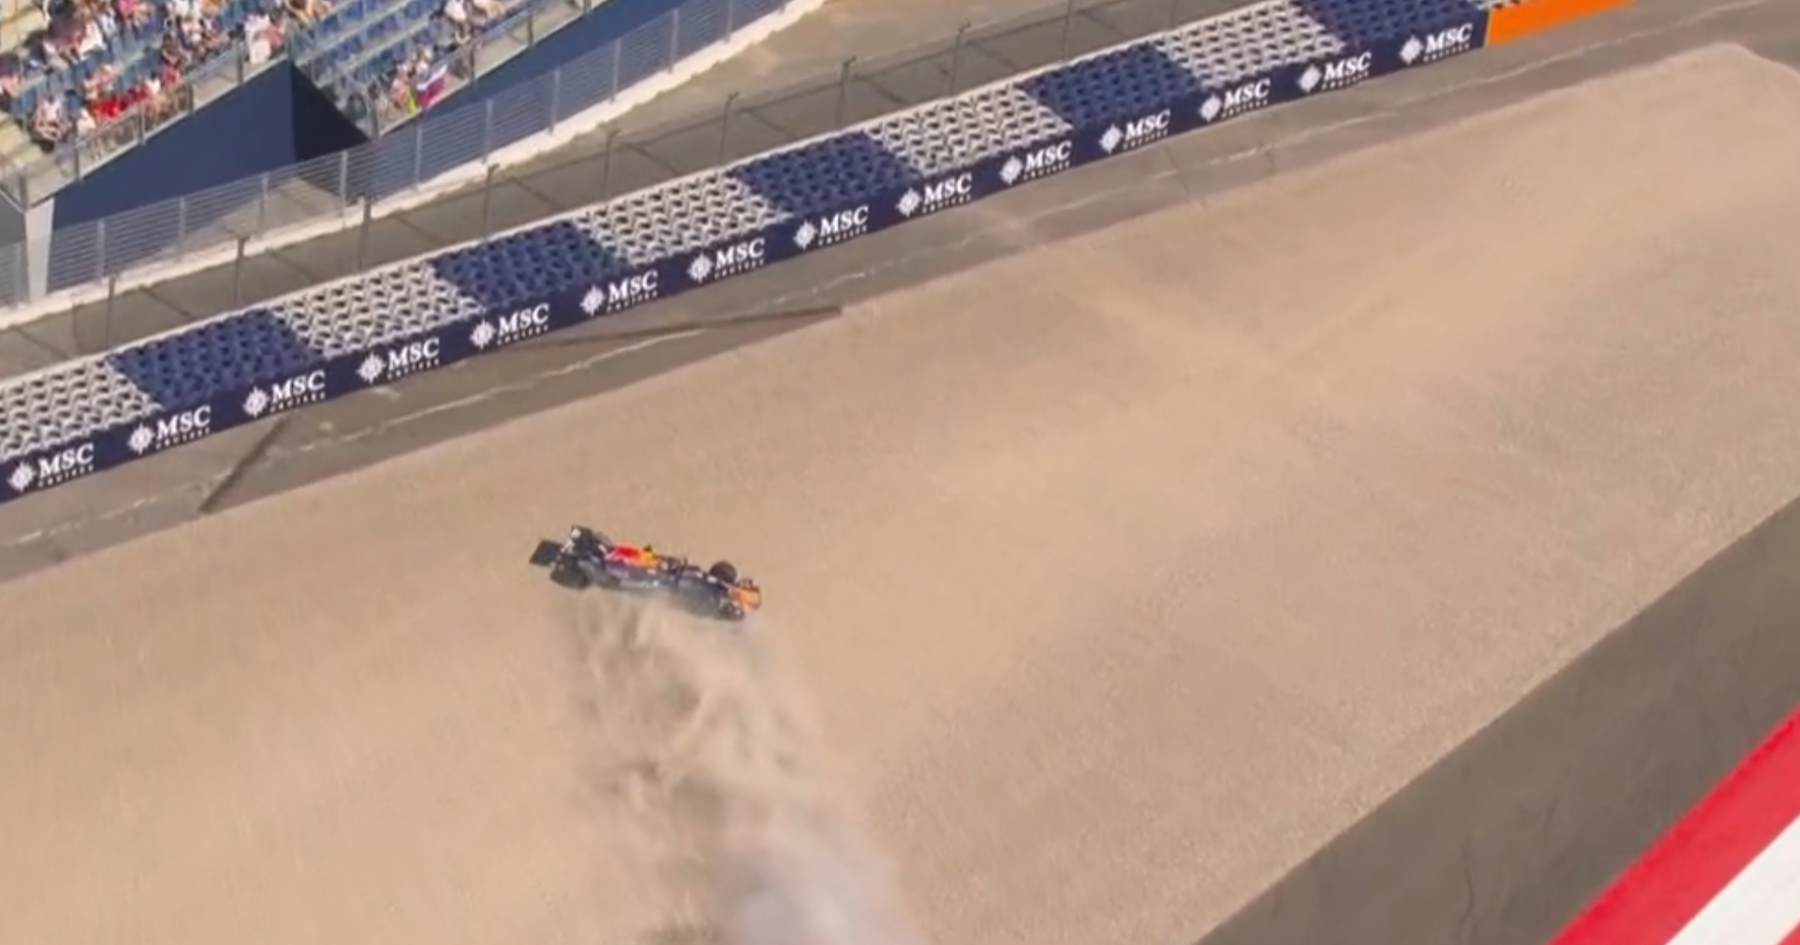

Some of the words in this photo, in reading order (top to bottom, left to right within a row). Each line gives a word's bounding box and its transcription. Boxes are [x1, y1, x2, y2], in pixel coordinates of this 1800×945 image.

[1425, 22, 1472, 53] MSC
[1324, 51, 1372, 81] MSC
[1224, 78, 1270, 108] MSC
[1125, 109, 1171, 140] MSC
[1025, 140, 1072, 171] MSC
[924, 172, 972, 204] MSC
[820, 205, 869, 237] MSC
[716, 238, 765, 269] MSC
[608, 270, 657, 303] MSC
[499, 303, 549, 337] MSC
[388, 337, 439, 370] MSC
[272, 370, 325, 402] MSC
[157, 405, 211, 439] MSC
[37, 443, 94, 477] MSC
